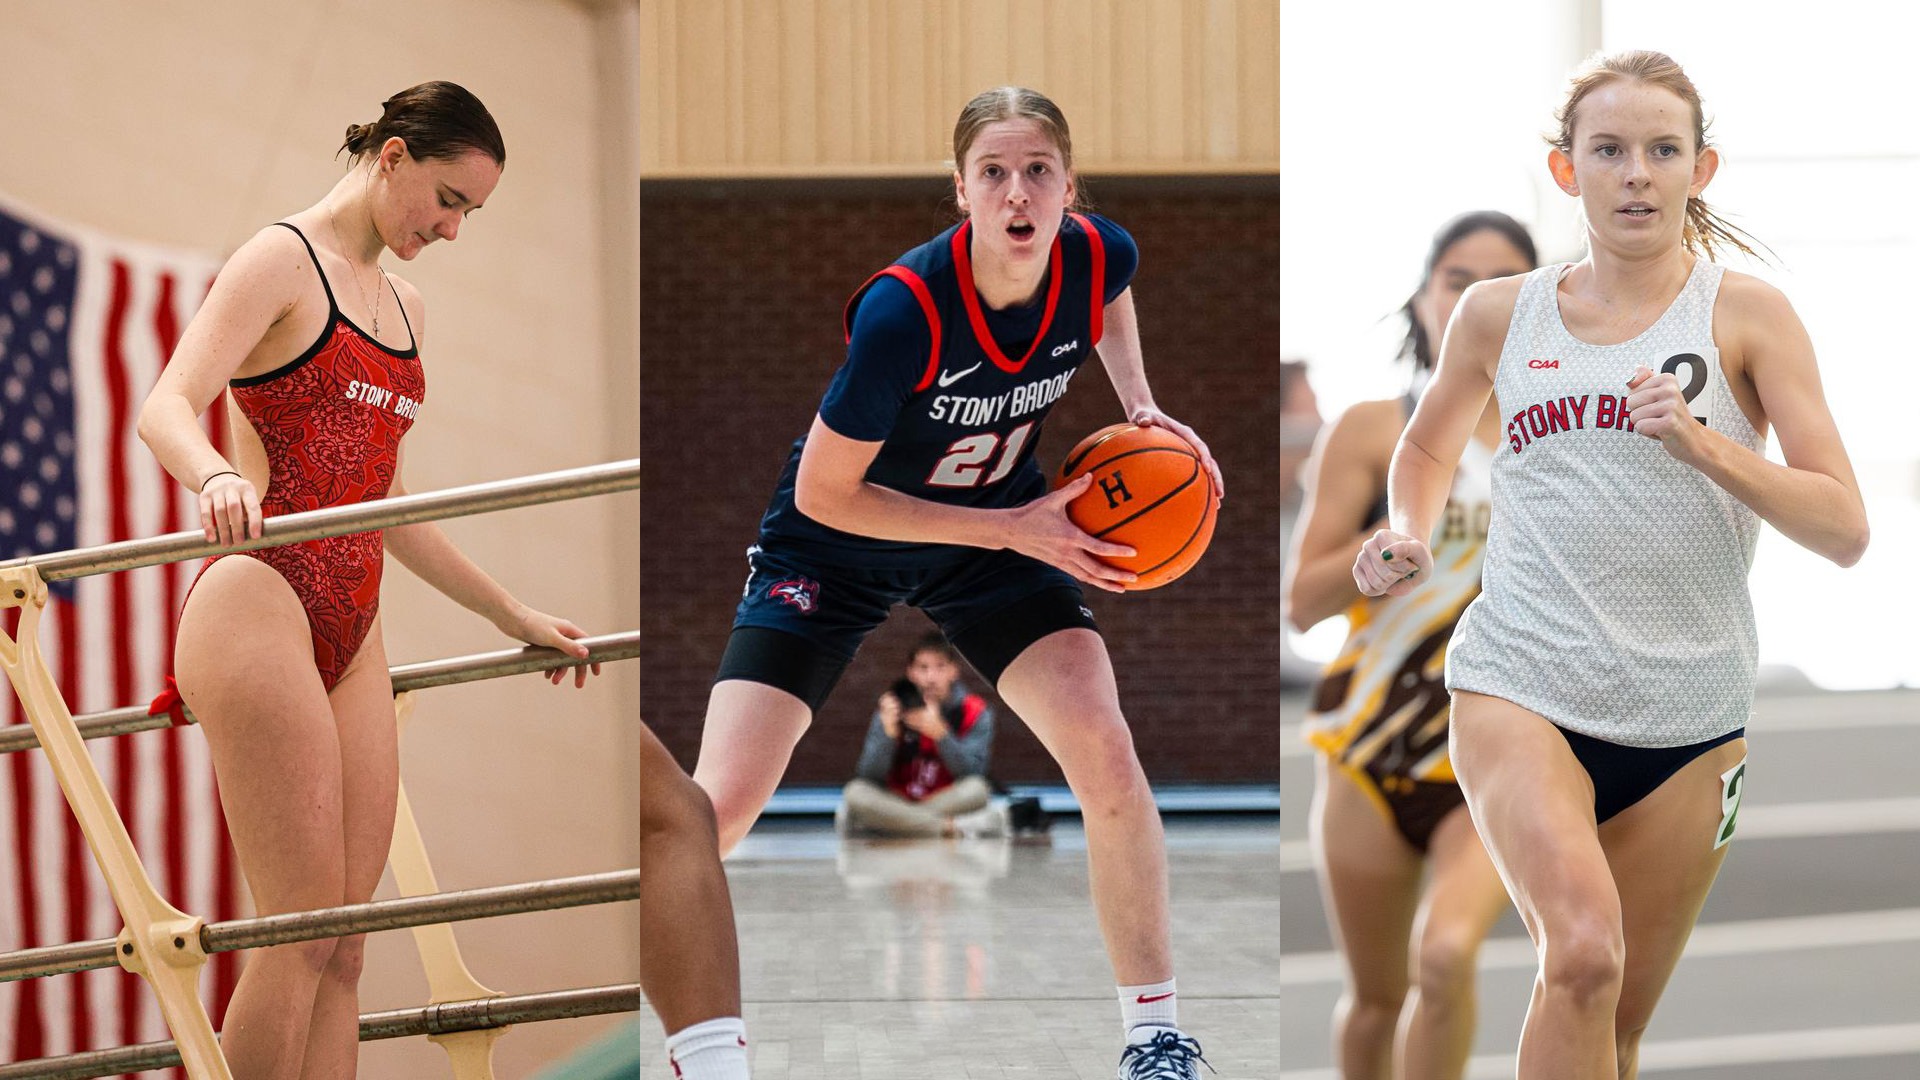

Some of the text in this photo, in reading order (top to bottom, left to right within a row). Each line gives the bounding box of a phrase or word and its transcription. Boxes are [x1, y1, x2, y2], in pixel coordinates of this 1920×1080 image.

[1051, 340, 1077, 357] CAA
[1528, 359, 1560, 370] CAA
[345, 380, 421, 420] STONY BRO
[928, 367, 1077, 427] STONY BROOK
[1507, 394, 1590, 455] STONY
[925, 420, 1035, 488] 21
[1098, 469, 1133, 510] H
[1719, 763, 1746, 843] 2
